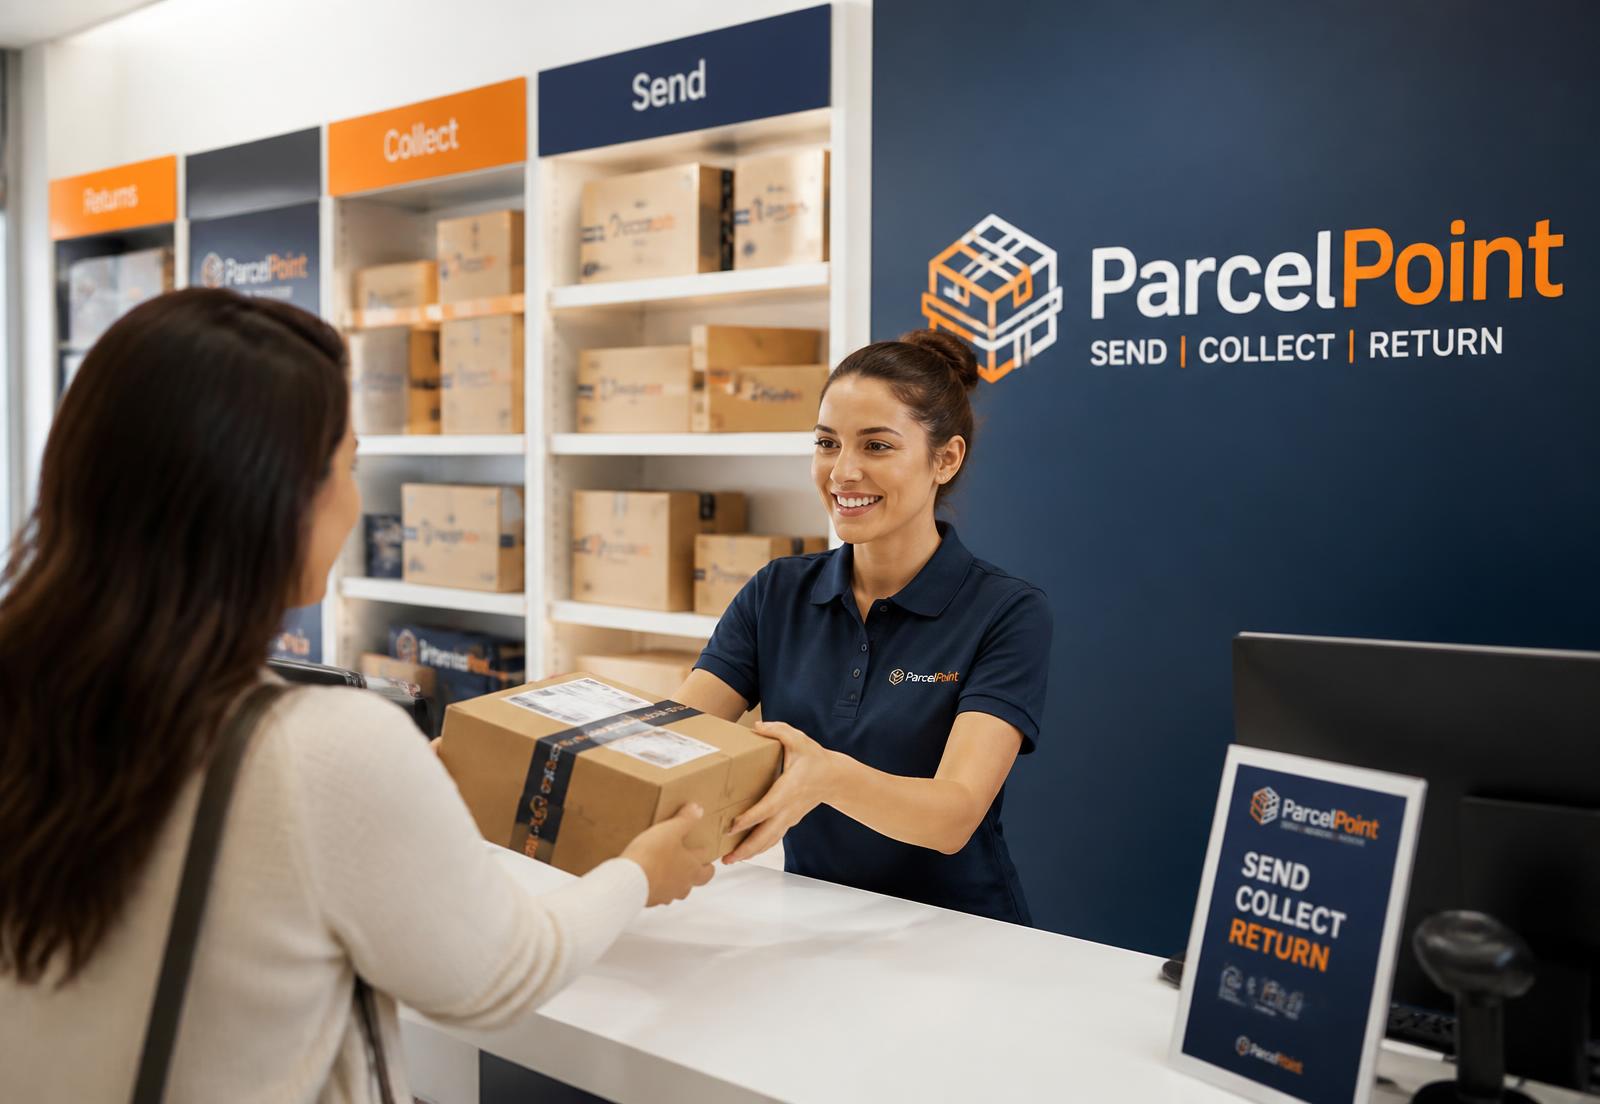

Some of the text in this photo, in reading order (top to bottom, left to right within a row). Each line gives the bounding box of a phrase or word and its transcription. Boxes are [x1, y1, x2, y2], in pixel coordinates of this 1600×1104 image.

[632, 58, 706, 111] Send
[384, 118, 459, 163] Collect
[1091, 219, 1565, 320] ParcelPoint
[1090, 326, 1504, 367] SEND COLLECT RETURN
[905, 671, 960, 683] ParcelPoint
[1282, 798, 1379, 840] ParcelPoint
[1241, 851, 1311, 892] SEND
[1235, 886, 1347, 939] COLLECT
[1229, 918, 1330, 973] RETURN
